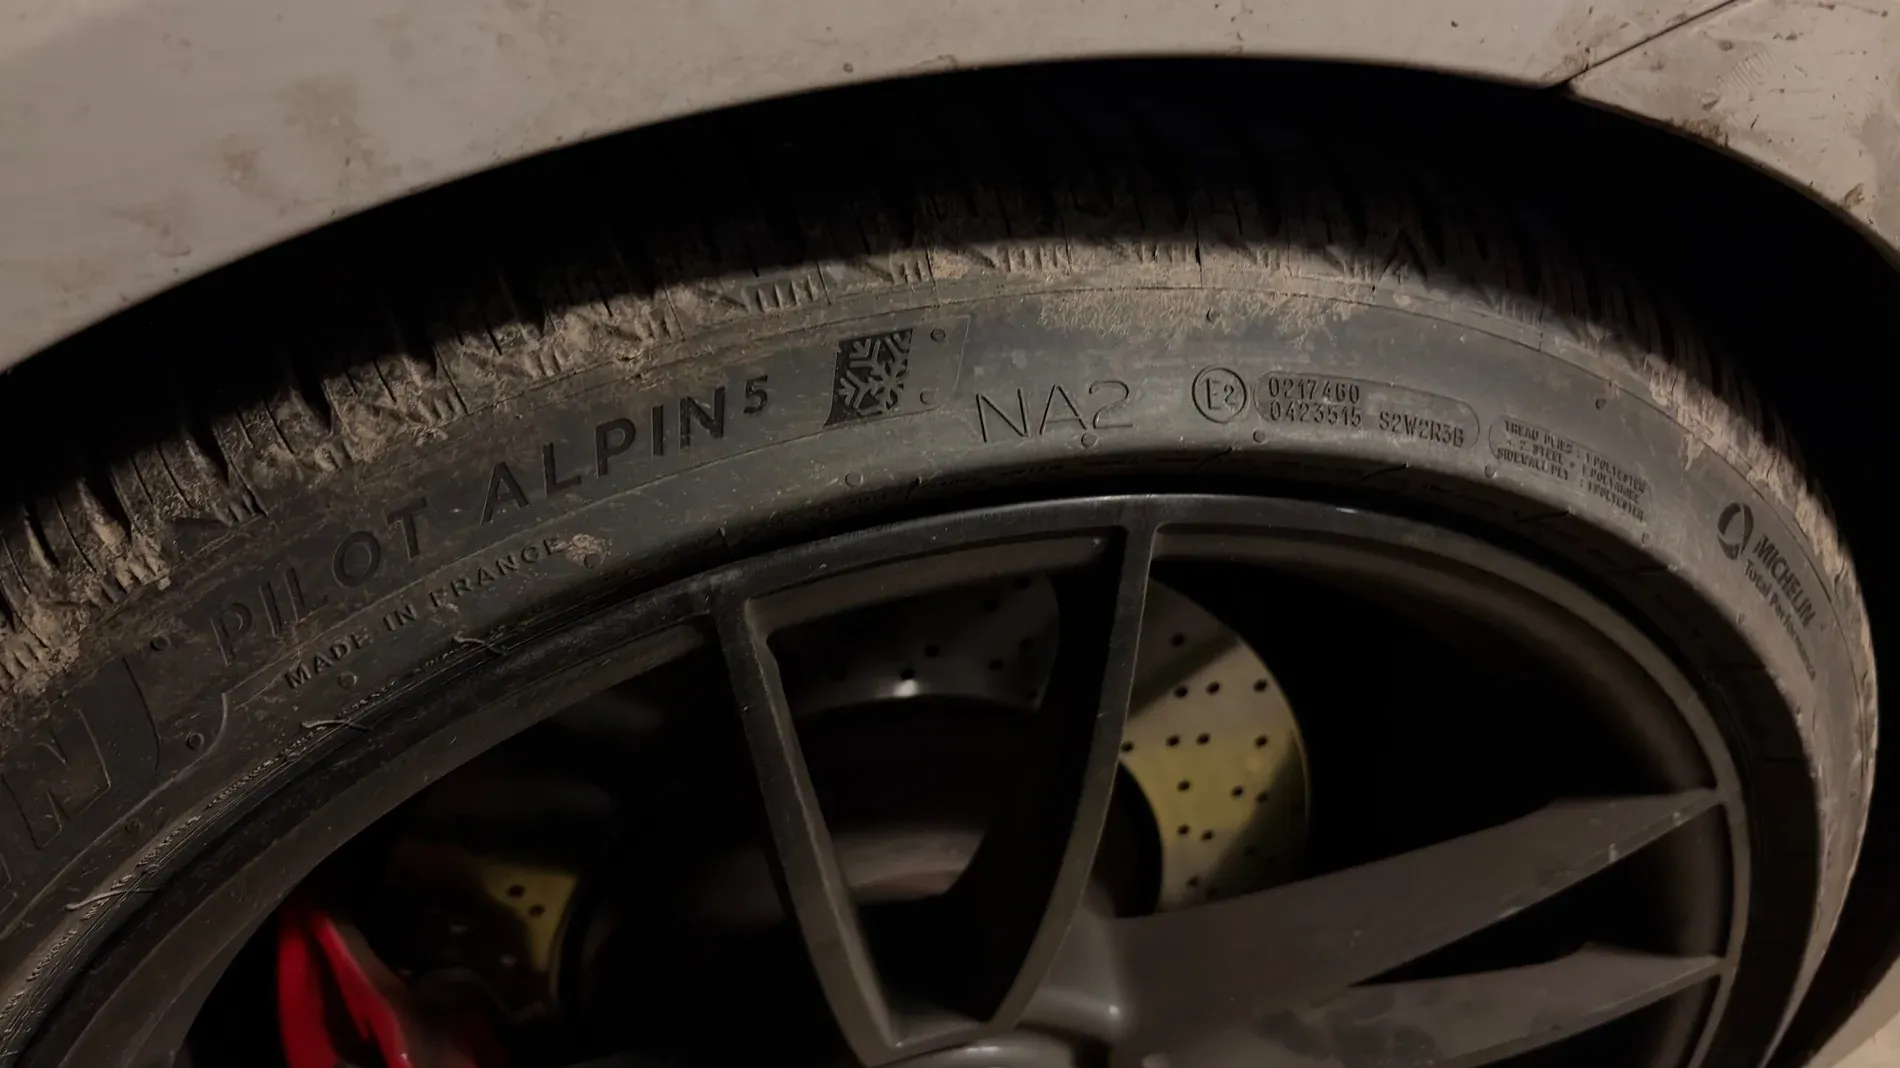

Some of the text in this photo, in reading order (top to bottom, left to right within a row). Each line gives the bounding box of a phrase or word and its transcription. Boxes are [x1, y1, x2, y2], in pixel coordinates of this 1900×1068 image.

[974, 379, 1134, 444] NA2
[1268, 400, 1363, 428] 0423515
[209, 497, 429, 667] PILOT
[282, 535, 570, 690] MADE IN FRANCE
[1743, 557, 1817, 682] Total Perforce
[1752, 533, 1817, 629] MICHELIN
